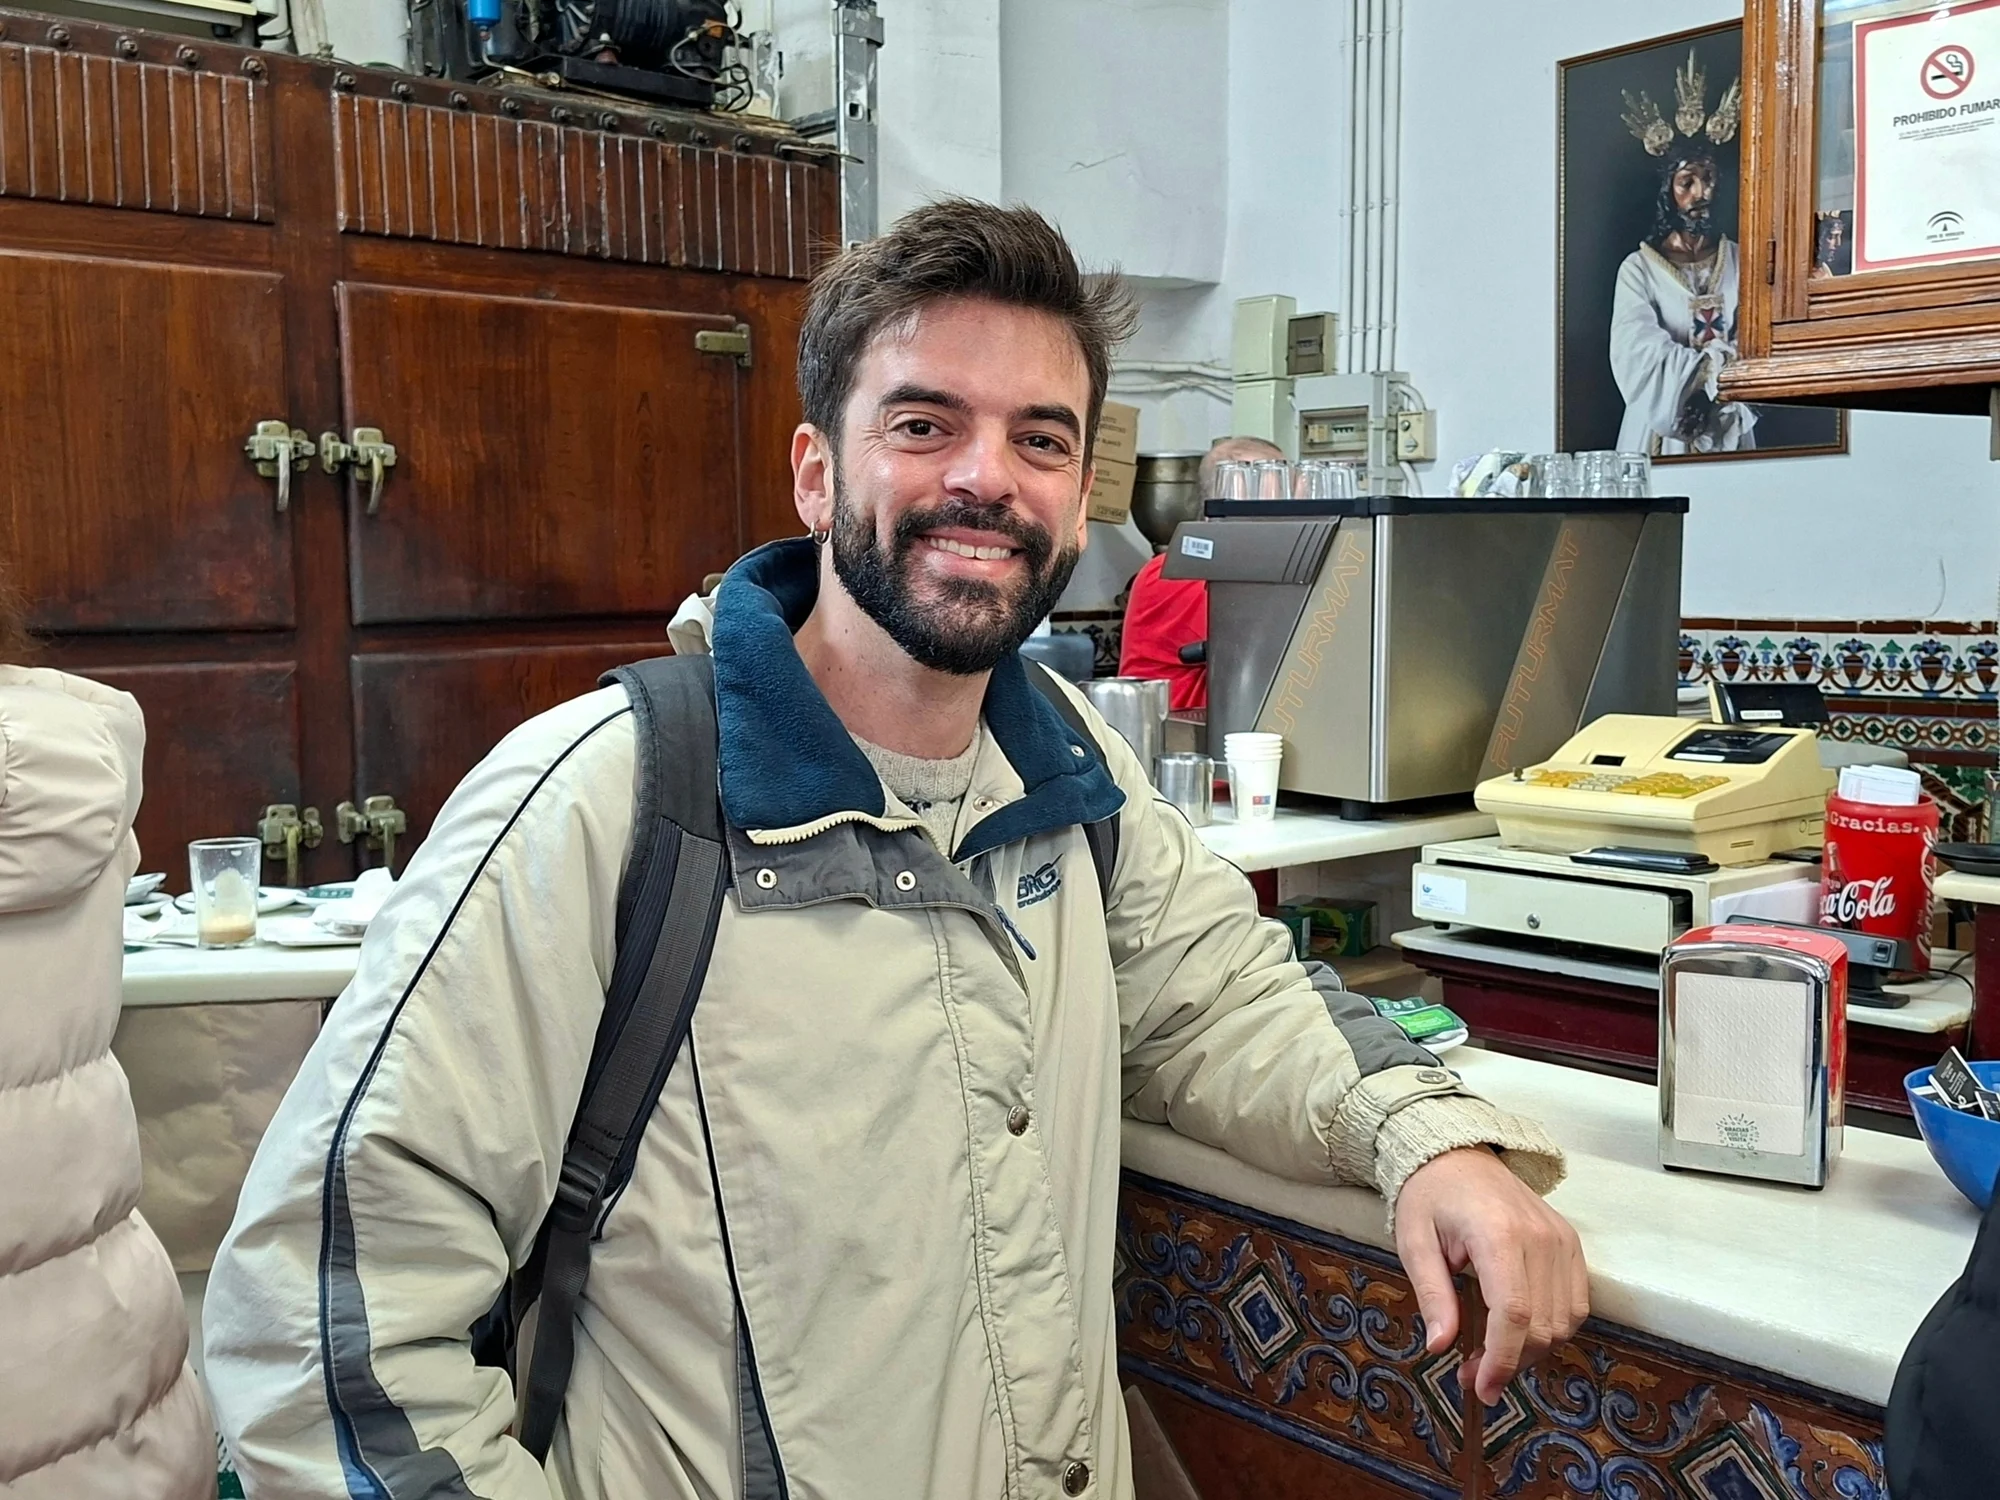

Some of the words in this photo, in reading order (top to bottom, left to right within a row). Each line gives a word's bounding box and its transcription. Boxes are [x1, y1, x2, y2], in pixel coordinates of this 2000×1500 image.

[1893, 107, 1956, 127] PROHIBIDO
[1960, 98, 2000, 116] FUMAR
[1265, 532, 1365, 739] UTURMAT
[1491, 528, 1580, 770] FUTURMAT
[1830, 811, 1920, 833] Gracias.
